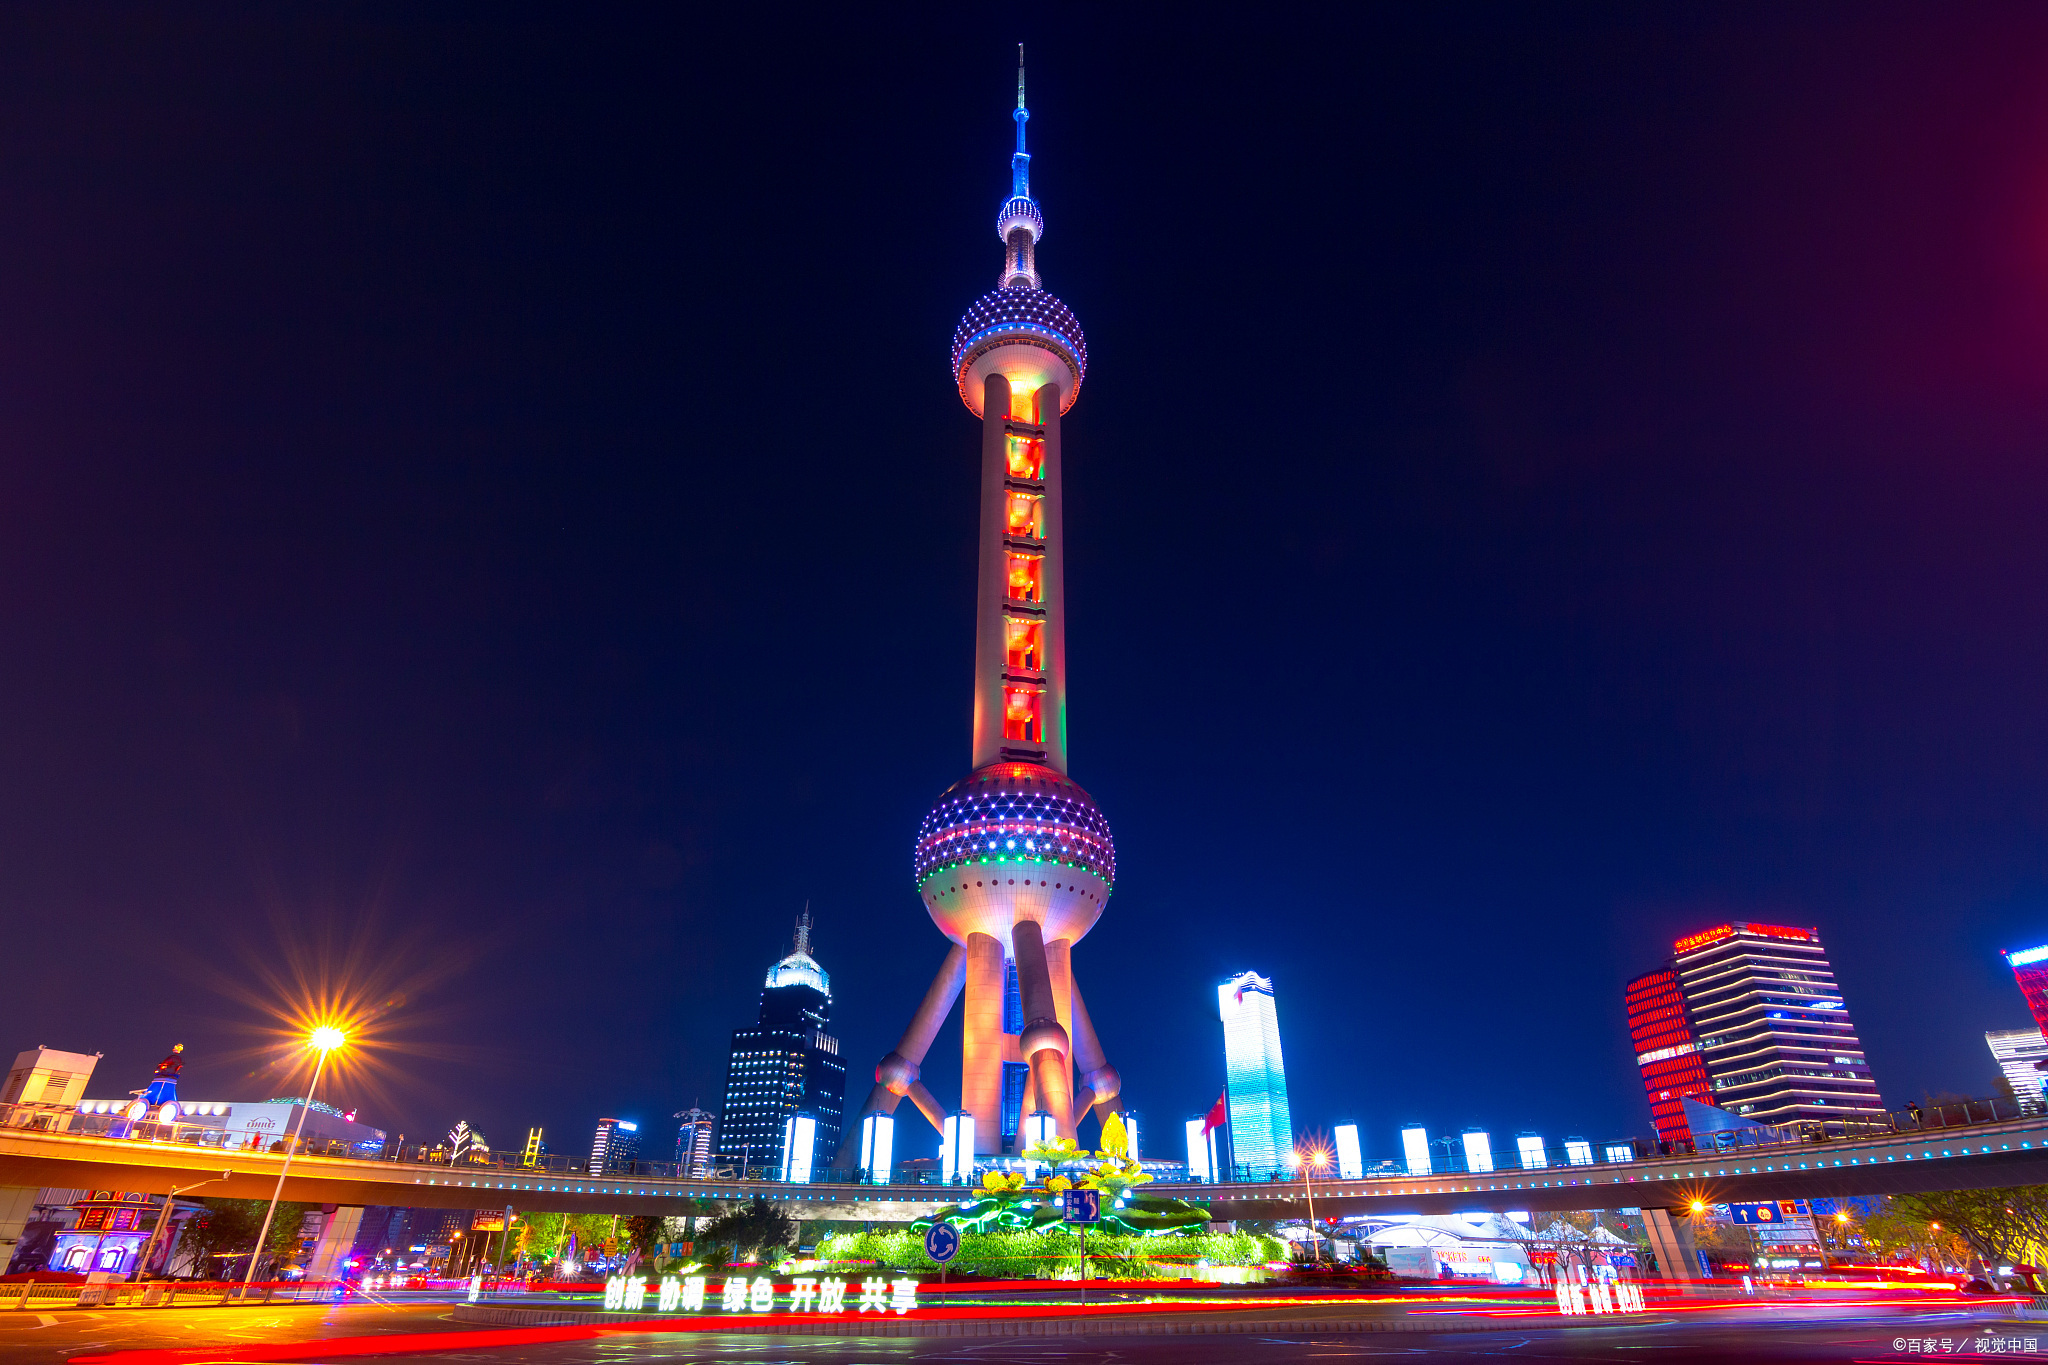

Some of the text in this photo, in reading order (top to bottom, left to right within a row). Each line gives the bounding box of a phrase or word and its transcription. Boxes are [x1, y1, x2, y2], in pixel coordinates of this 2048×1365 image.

[604, 1275, 919, 1315] 创新 协调 绿色 开放 共享
